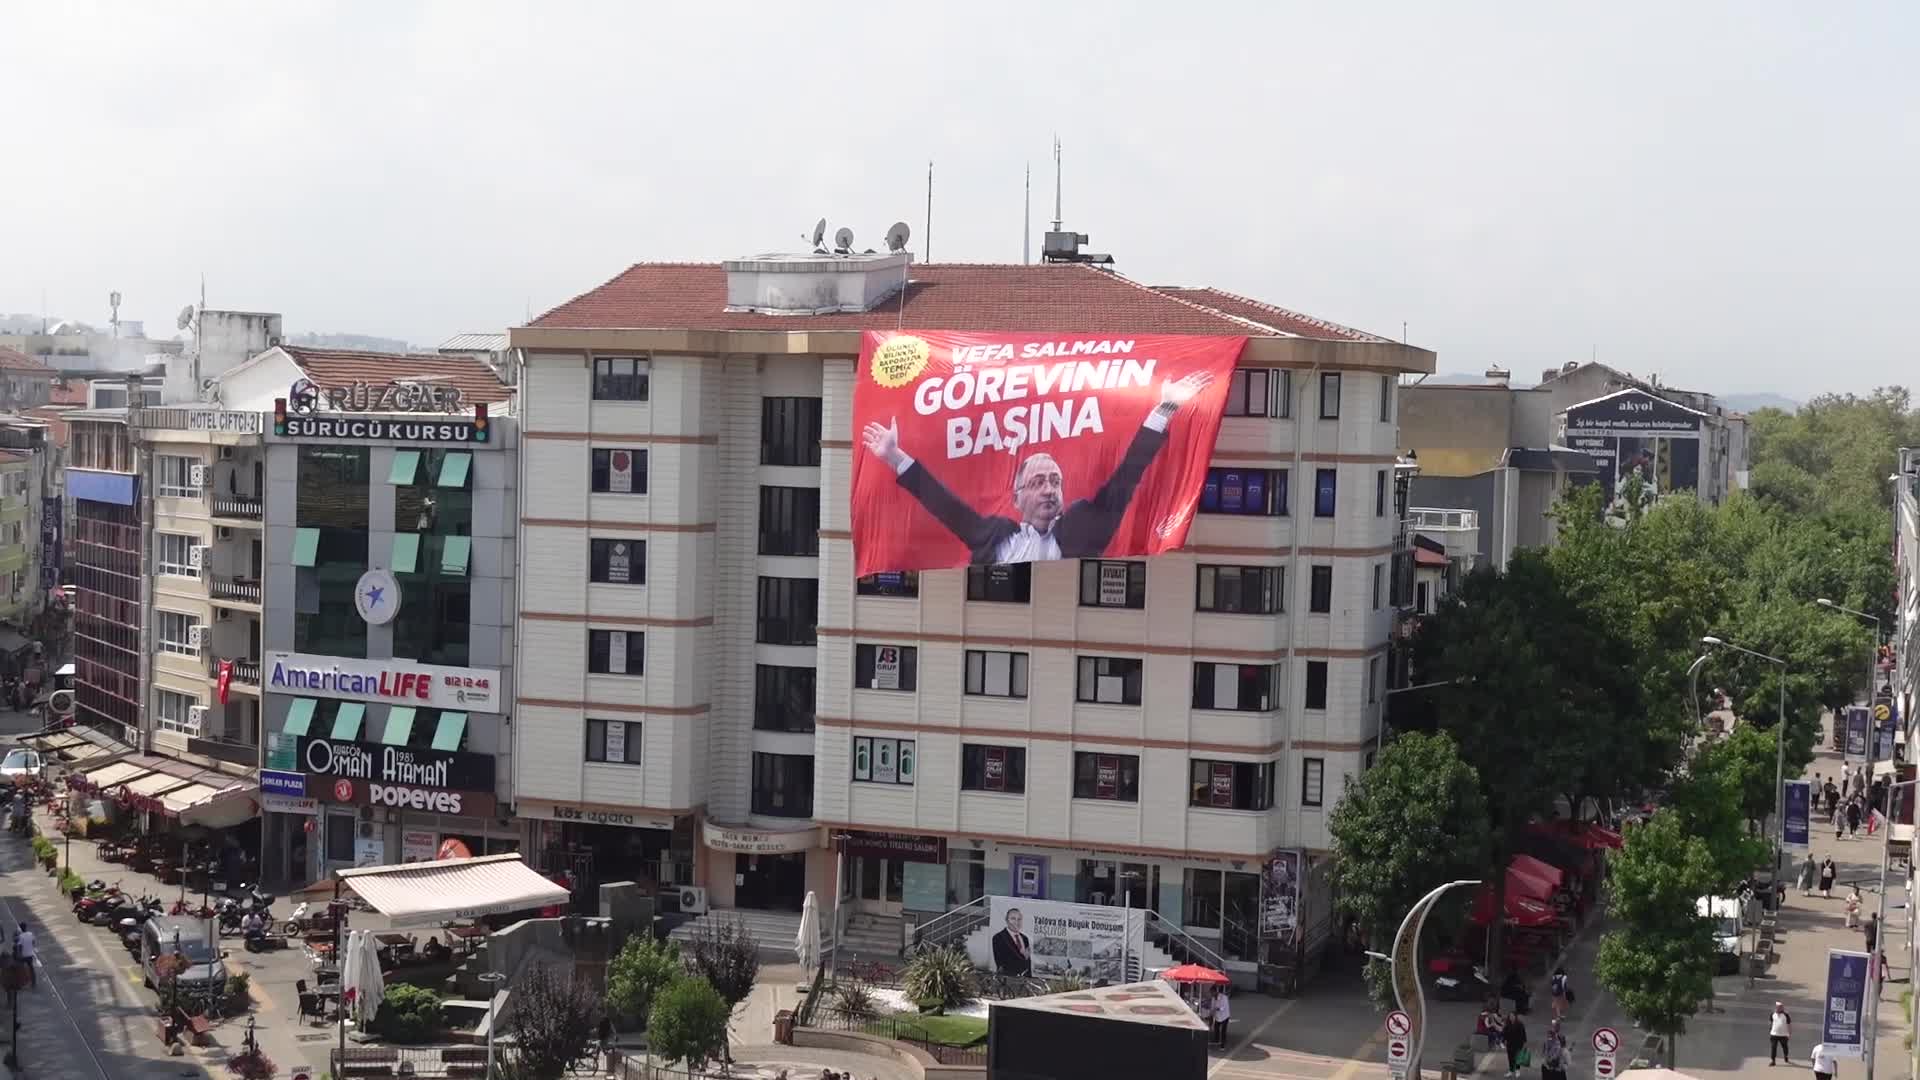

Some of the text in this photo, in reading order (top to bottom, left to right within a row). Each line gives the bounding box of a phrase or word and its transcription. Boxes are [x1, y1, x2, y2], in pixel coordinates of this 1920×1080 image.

[952, 340, 1135, 364] VEFA SALMAN
[329, 379, 463, 413] RÜZGAR
[914, 359, 1157, 415] GÖREVİNİN
[1618, 401, 1653, 413] akyol
[190, 412, 217, 429] HOTEL
[287, 418, 469, 441] SÜRÜCÜ KURSU
[947, 396, 1103, 459] BAŞINA
[444, 676, 461, 687] 812
[553, 805, 582, 819] köz
